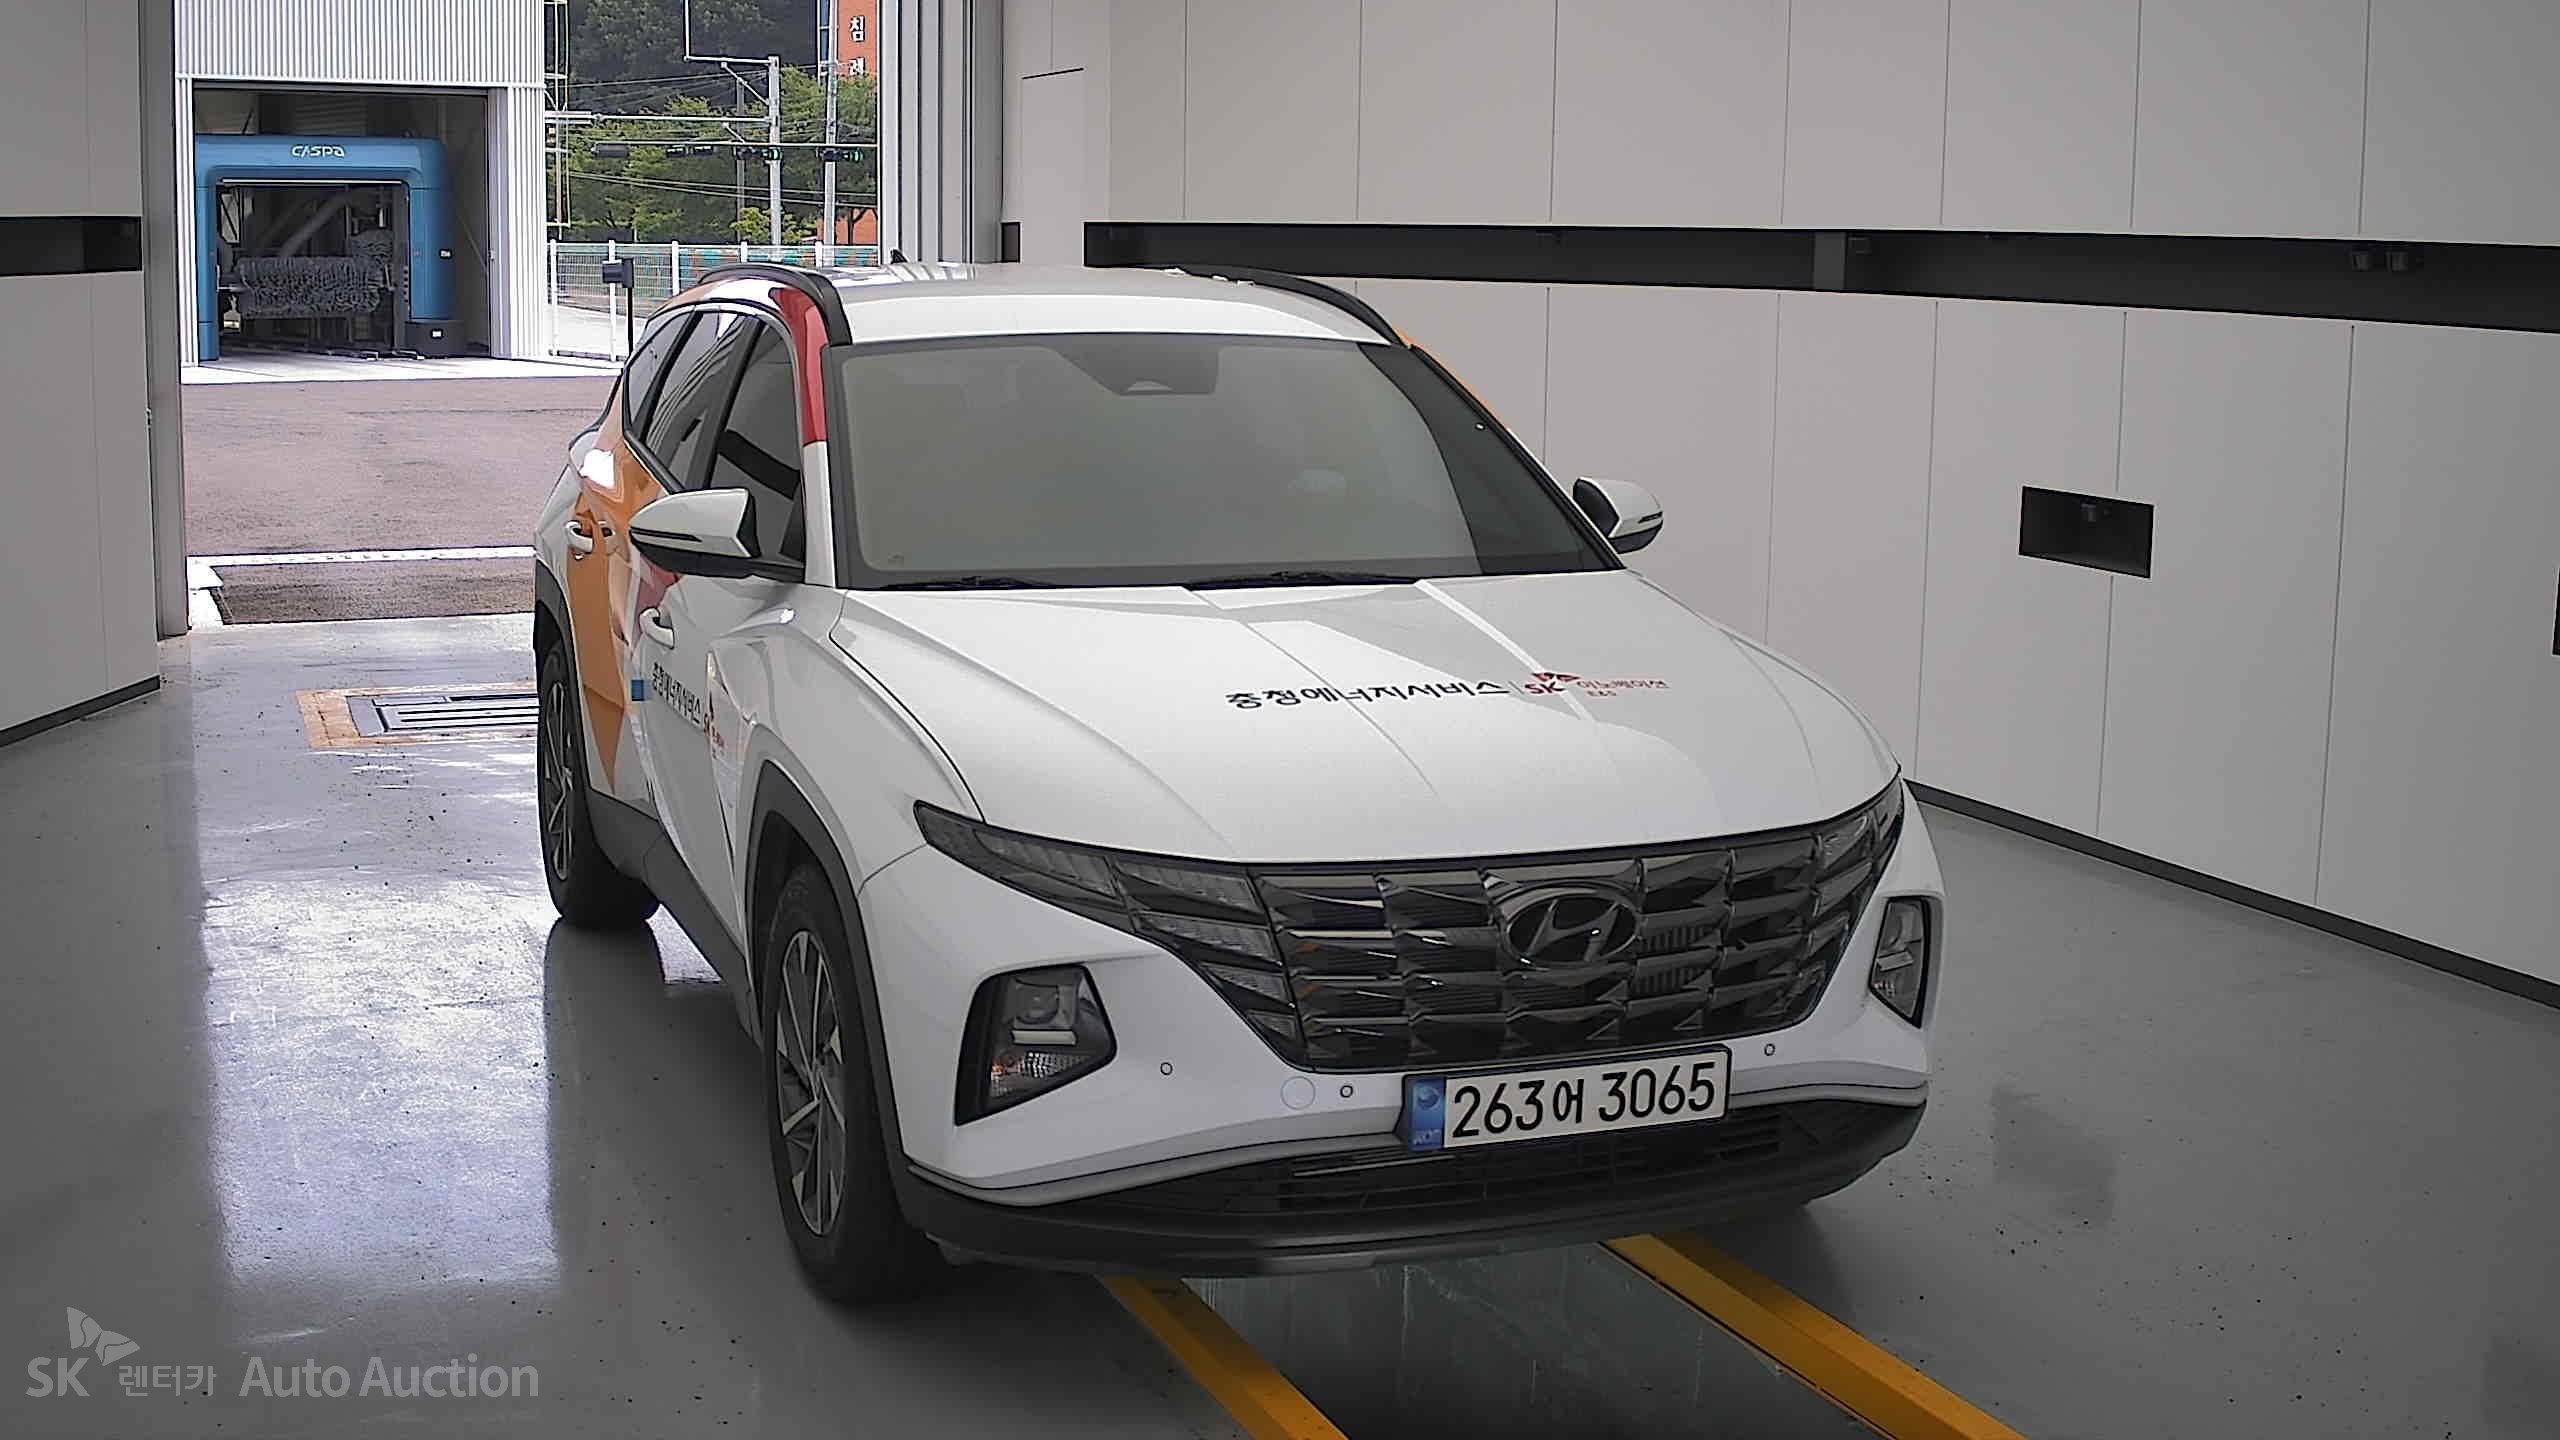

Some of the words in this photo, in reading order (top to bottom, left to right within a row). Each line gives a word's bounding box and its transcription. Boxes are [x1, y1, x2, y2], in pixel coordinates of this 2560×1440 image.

[1225, 680, 1511, 710] 충청에너지서비스
[1452, 1078, 1585, 1139] 263어
[1598, 1061, 1717, 1122] 3065
